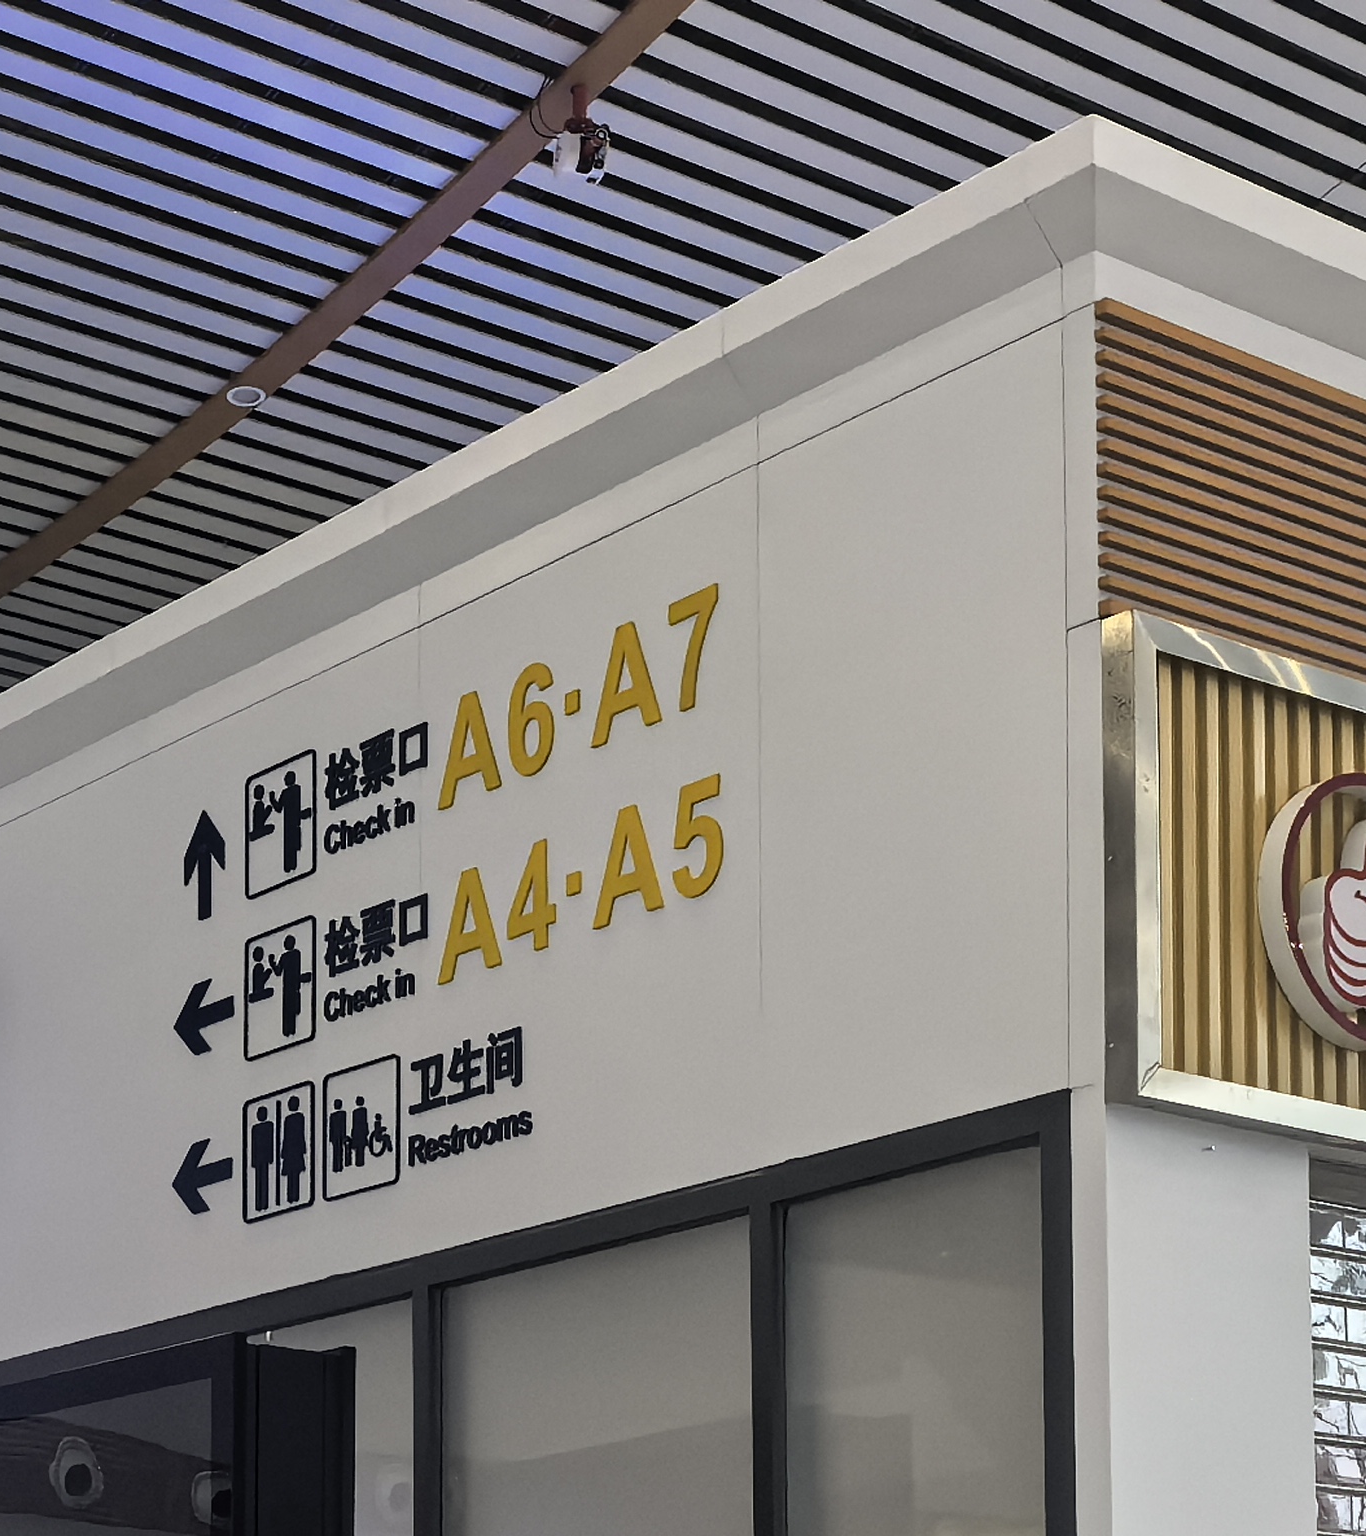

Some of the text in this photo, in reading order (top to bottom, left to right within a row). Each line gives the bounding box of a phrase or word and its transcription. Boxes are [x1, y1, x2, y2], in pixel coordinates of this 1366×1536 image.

[324, 721, 429, 811] 检票口
[323, 797, 416, 855] Check in
[324, 892, 429, 978] 检票口
[323, 968, 416, 1022] Check in
[408, 1026, 523, 1115] 卫生间
[408, 1107, 533, 1167] Restrooms
